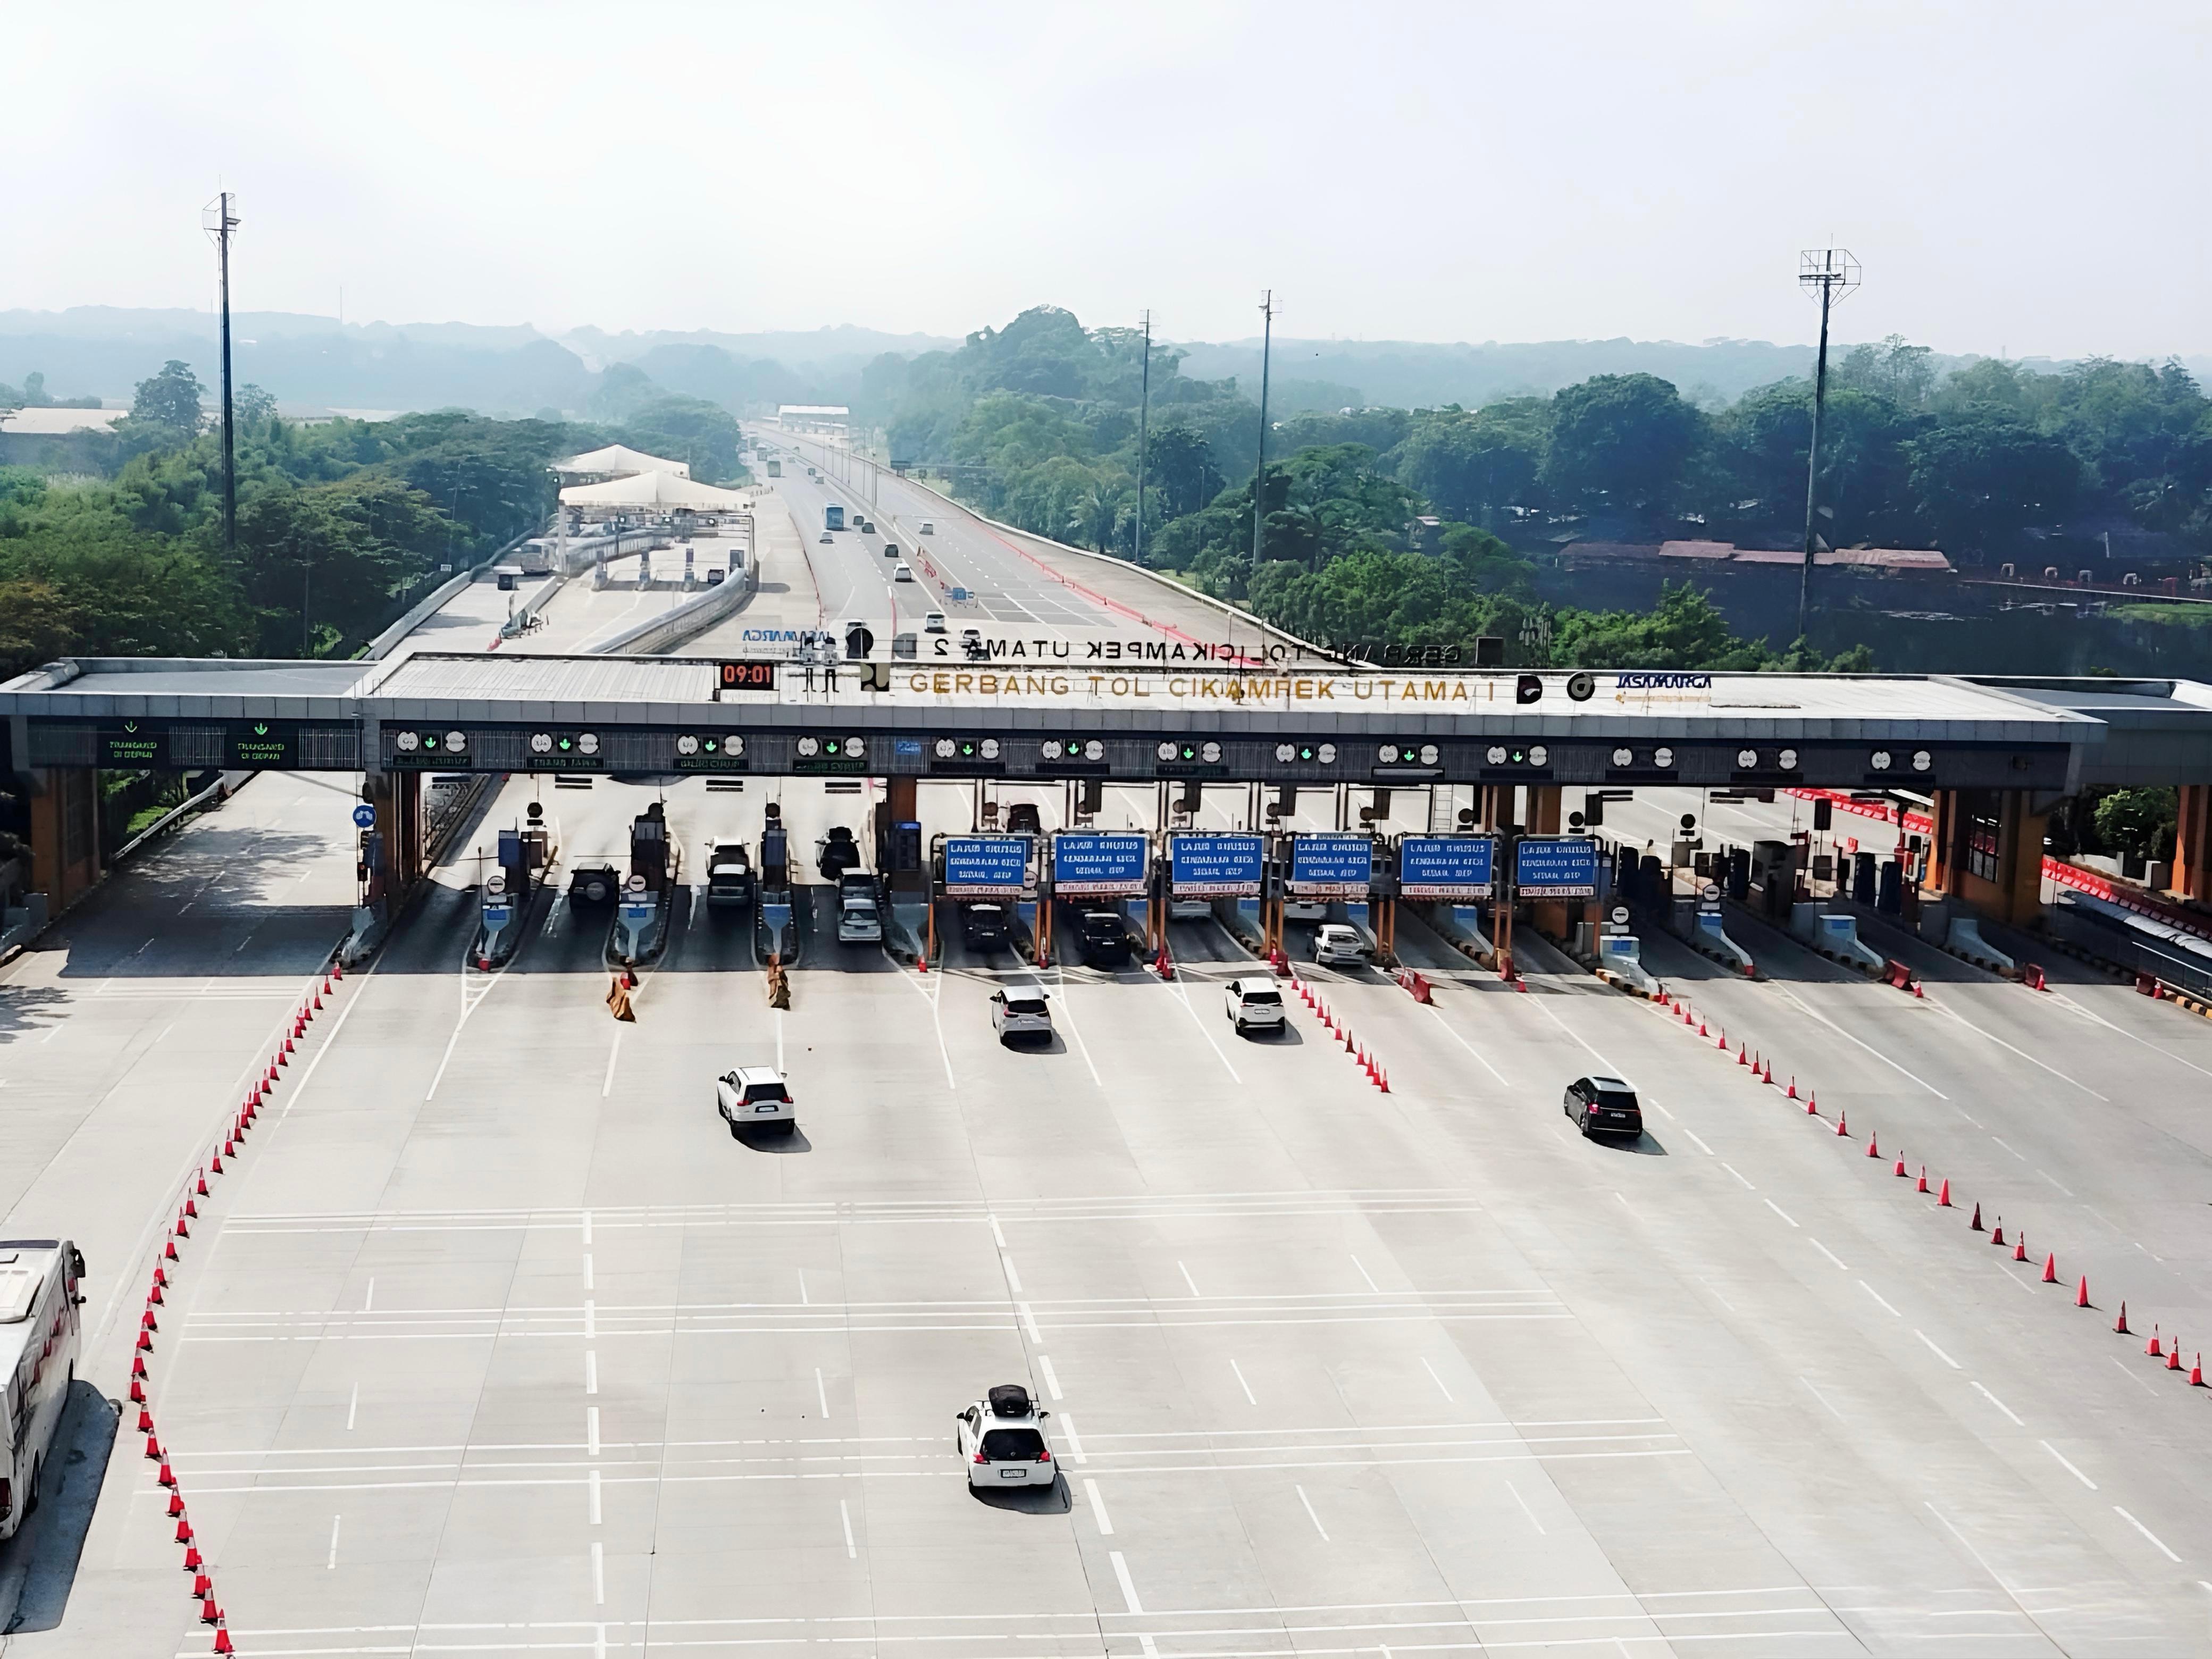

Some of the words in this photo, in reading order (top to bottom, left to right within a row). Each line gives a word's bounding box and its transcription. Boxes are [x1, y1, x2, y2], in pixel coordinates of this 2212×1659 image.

[724, 665, 771, 683] 09:01
[1616, 675, 1712, 689] JASAMARGA
[910, 673, 1068, 696] GERBANG
[1088, 676, 1150, 696] TOL
[1169, 677, 1335, 699] CIKAMPEK
[1354, 680, 1468, 701] UTAMA
